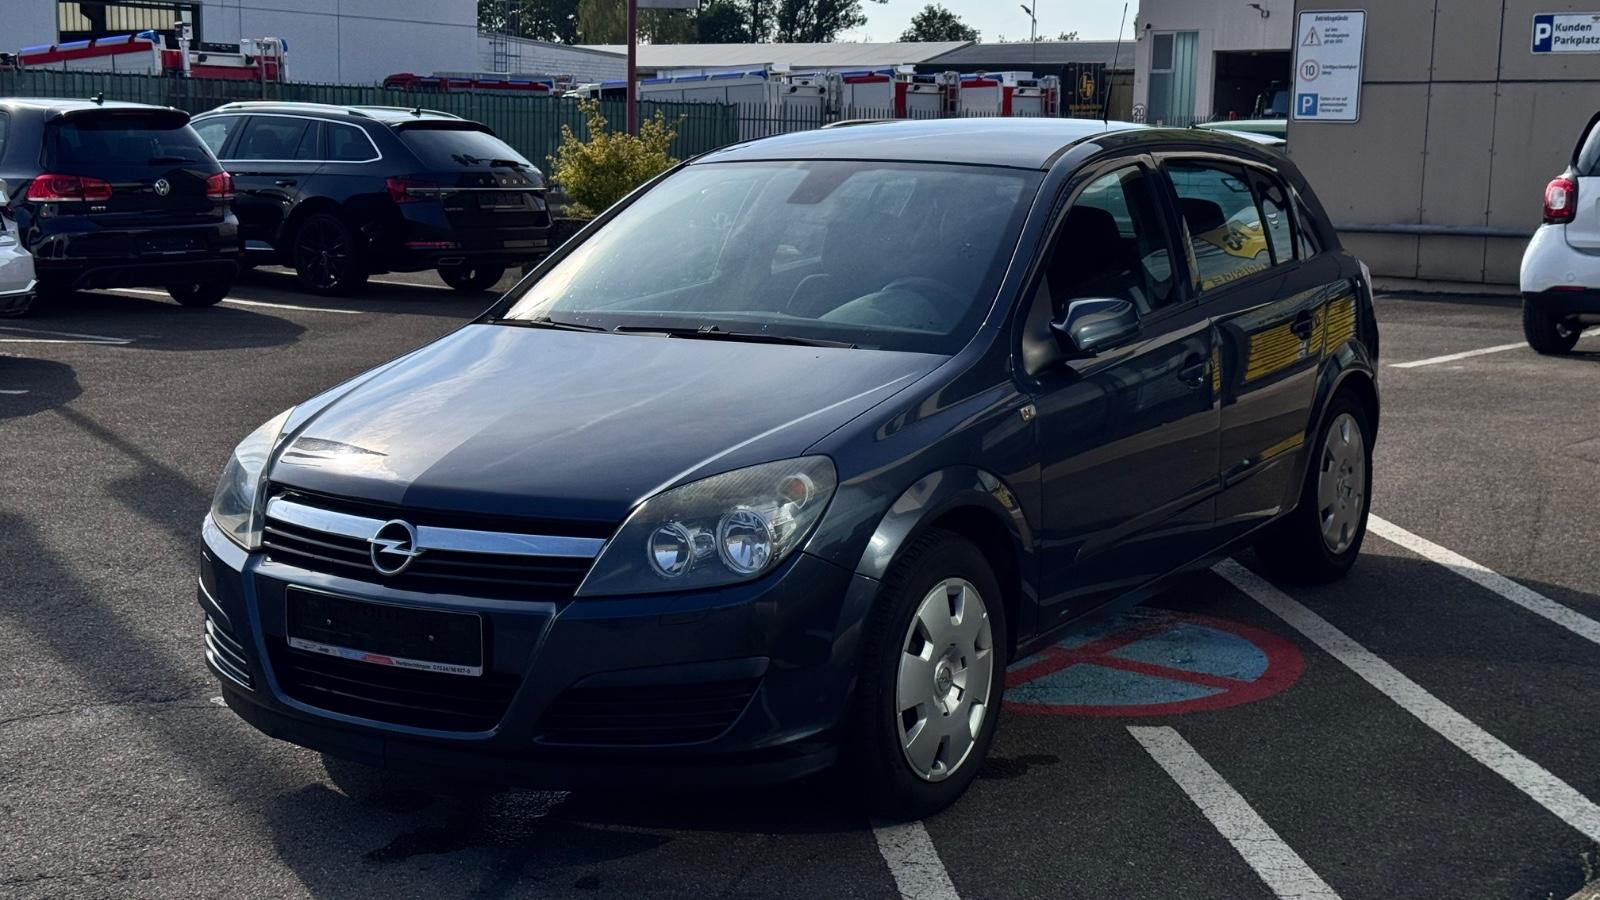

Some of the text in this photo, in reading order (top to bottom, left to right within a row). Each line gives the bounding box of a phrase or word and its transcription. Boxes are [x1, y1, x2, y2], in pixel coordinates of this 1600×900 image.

[1555, 23, 1592, 32] Kunden
[1535, 23, 1551, 45] P
[1554, 36, 1600, 46] Parkplatz
[1305, 65, 1315, 76] 10
[1303, 96, 1313, 113] P
